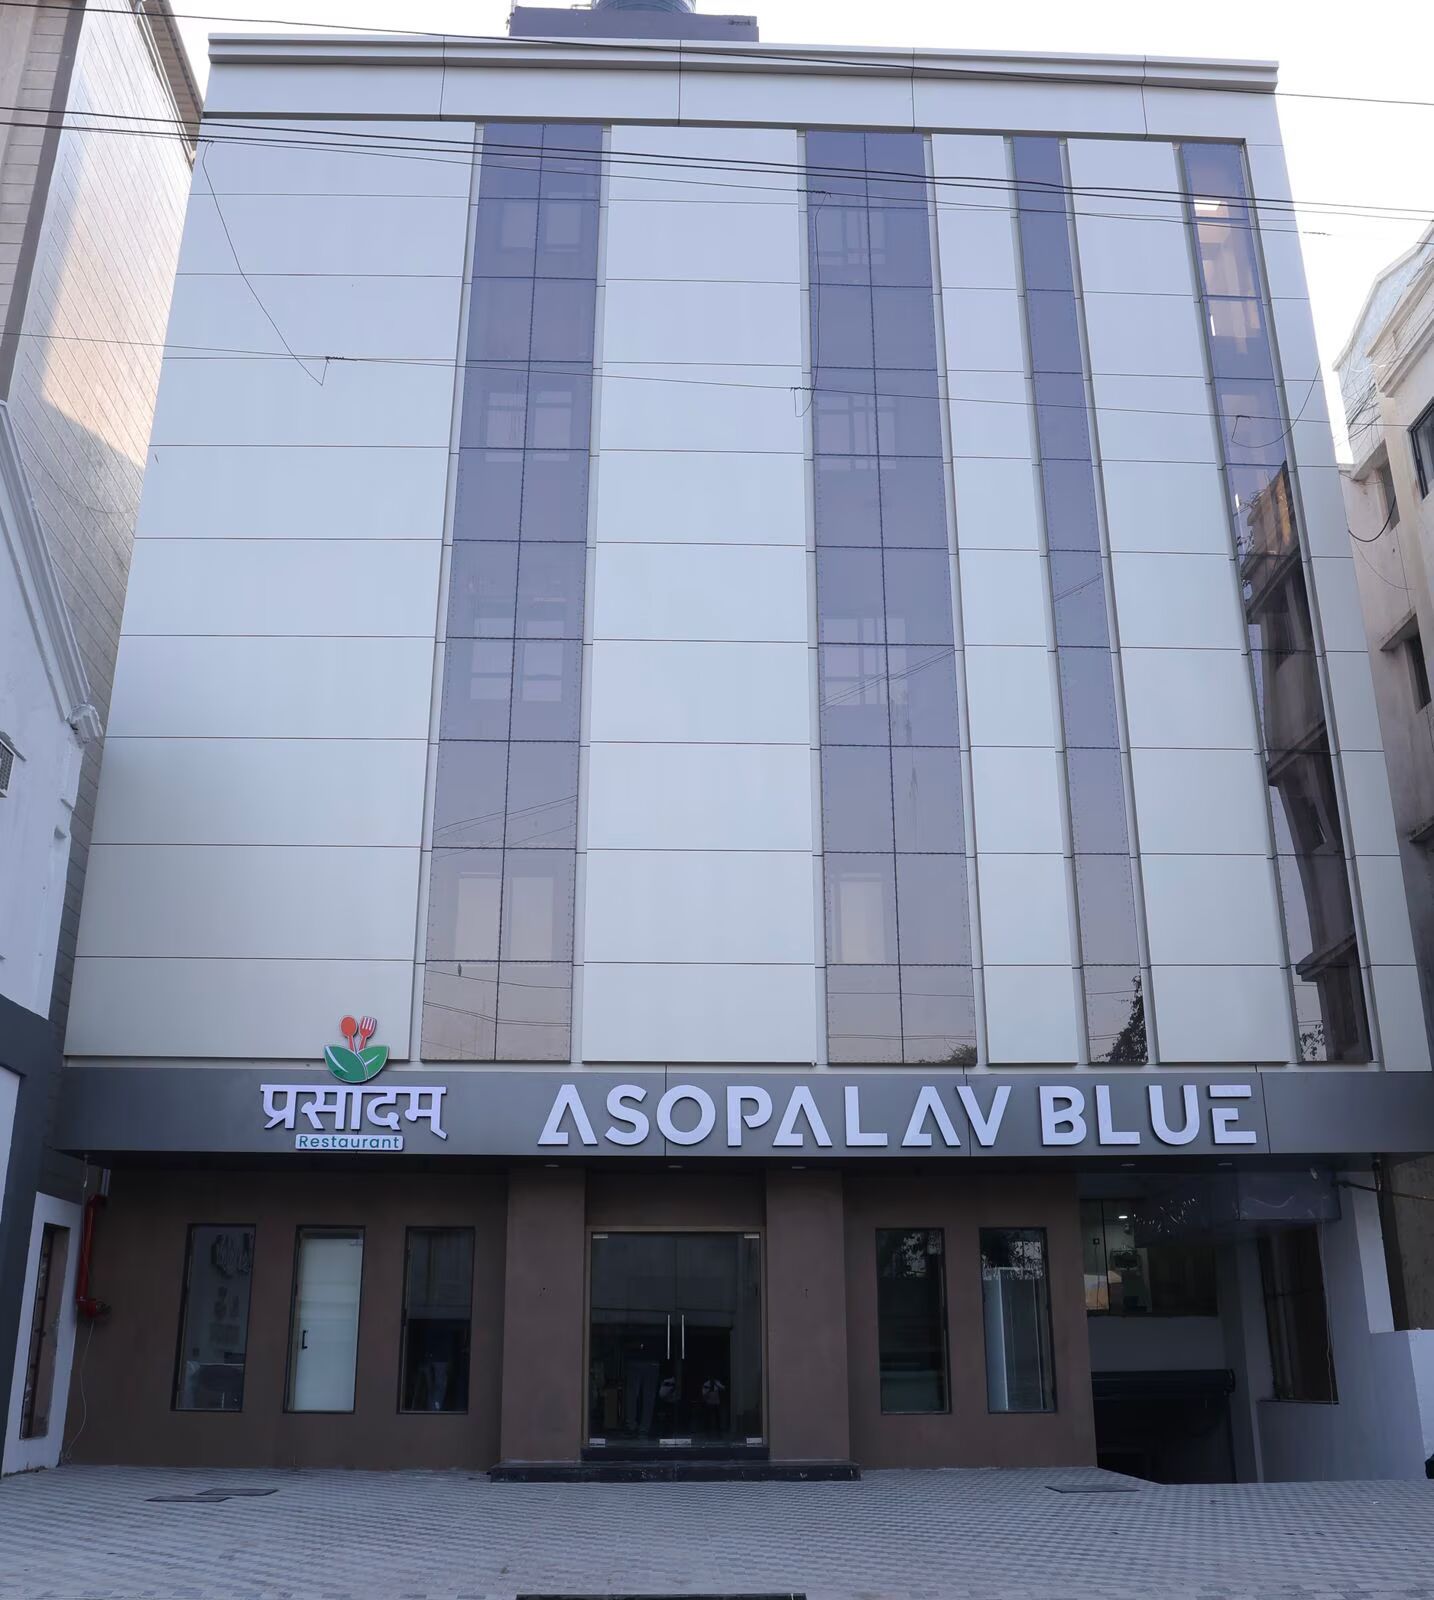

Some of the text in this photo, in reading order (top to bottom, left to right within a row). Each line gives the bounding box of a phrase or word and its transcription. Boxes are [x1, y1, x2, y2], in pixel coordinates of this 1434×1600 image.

[260, 1084, 447, 1140] प्रसादम्
[538, 1083, 1257, 1146] ASOPALAV BLUE
[299, 1136, 400, 1149] Restaurant
